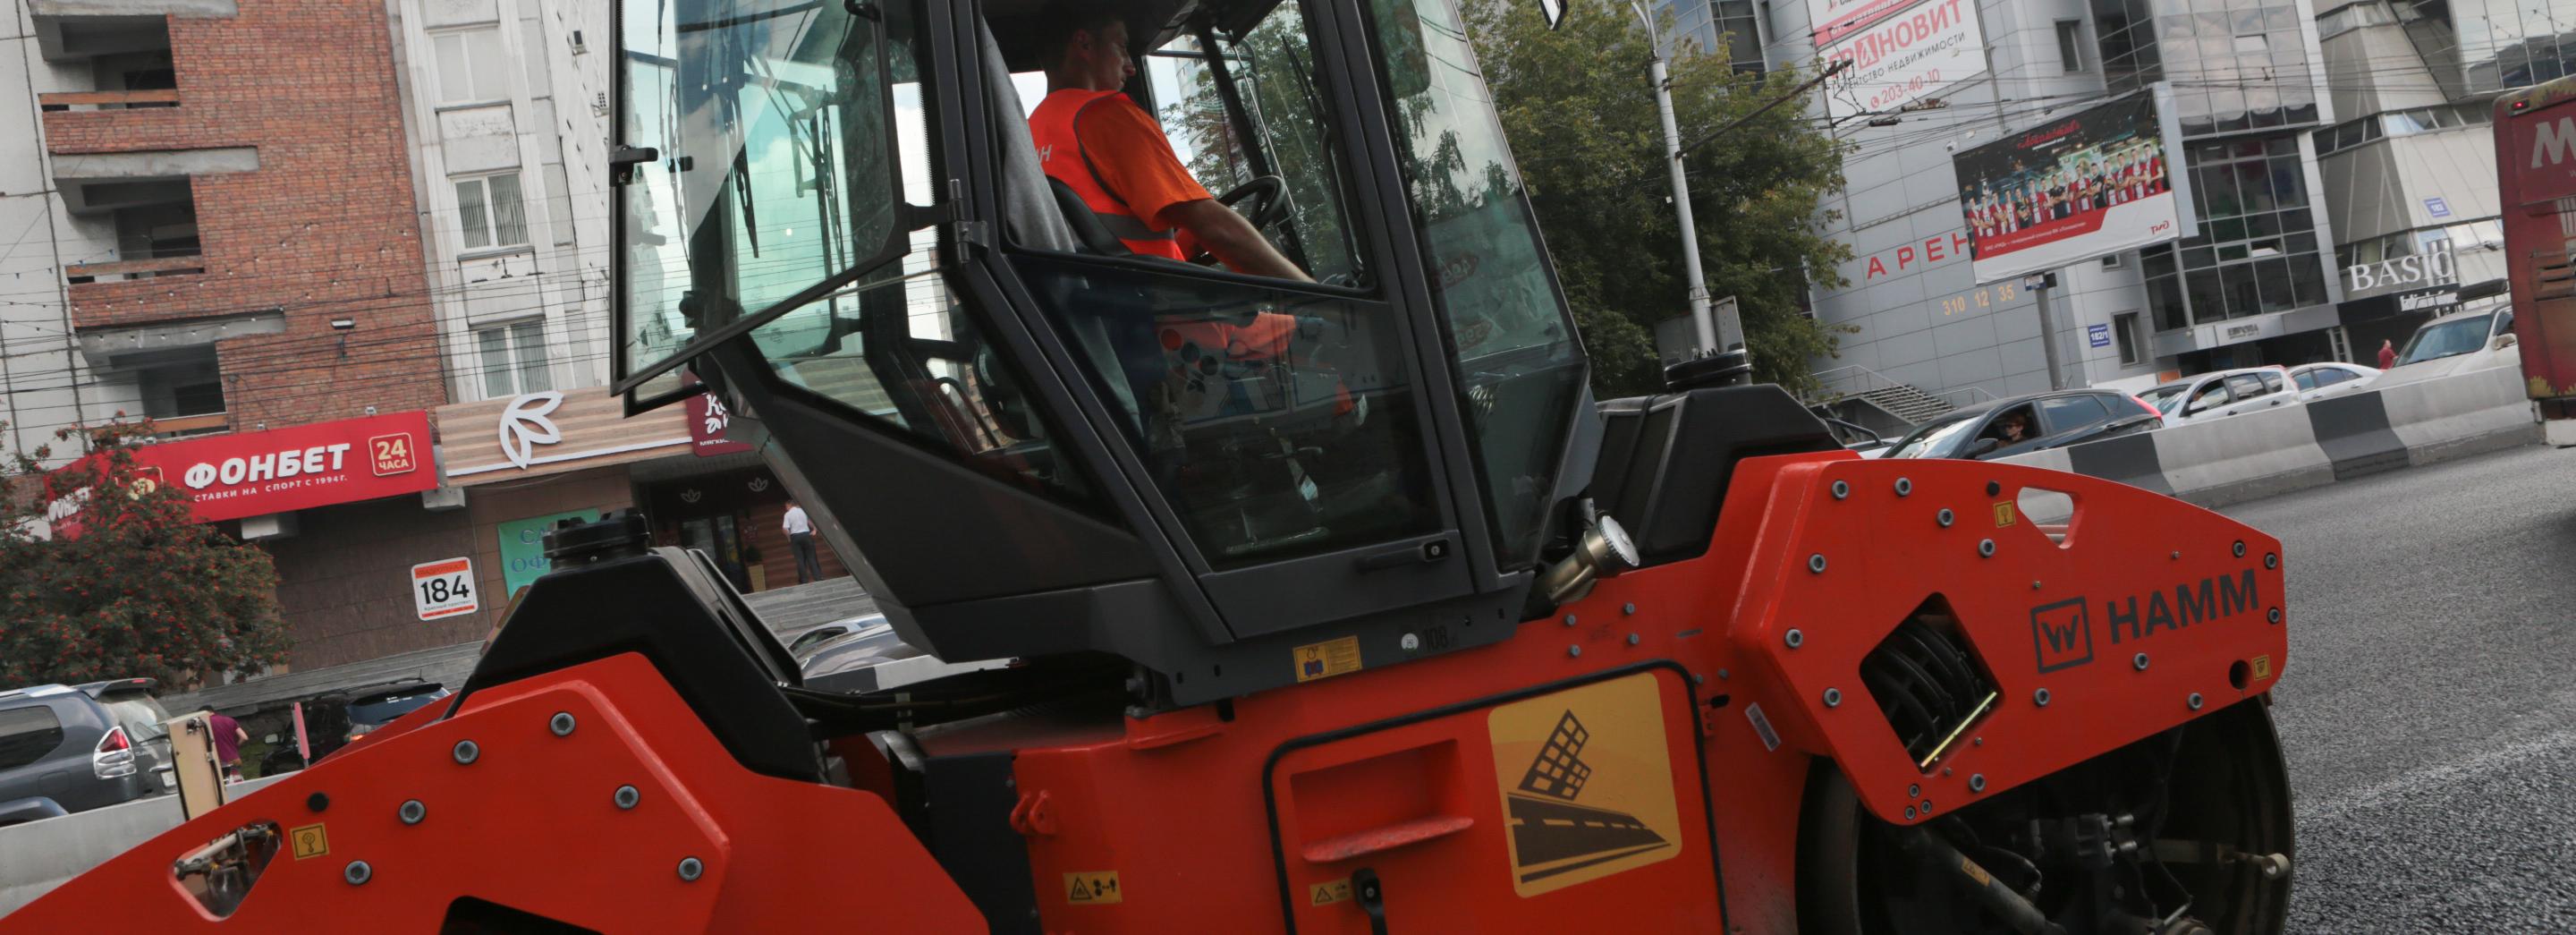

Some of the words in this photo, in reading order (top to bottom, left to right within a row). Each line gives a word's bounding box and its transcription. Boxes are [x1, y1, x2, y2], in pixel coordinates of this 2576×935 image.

[1888, 32, 1965, 72] НЕДВИЖИМОСТИ
[1882, 68, 1940, 104] 203-40-10
[1942, 296, 1965, 316] 310
[1974, 291, 1990, 308] 12
[1998, 284, 2015, 302] 35
[377, 438, 407, 461] 24
[378, 459, 409, 472] ЧАСА
[184, 443, 351, 489] ФОНБЕТ
[194, 489, 238, 502] СТАВКИ
[242, 488, 257, 496] НА
[266, 479, 301, 492] СПОРТ
[420, 574, 470, 605] 184
[2106, 568, 2259, 644] HAMM
